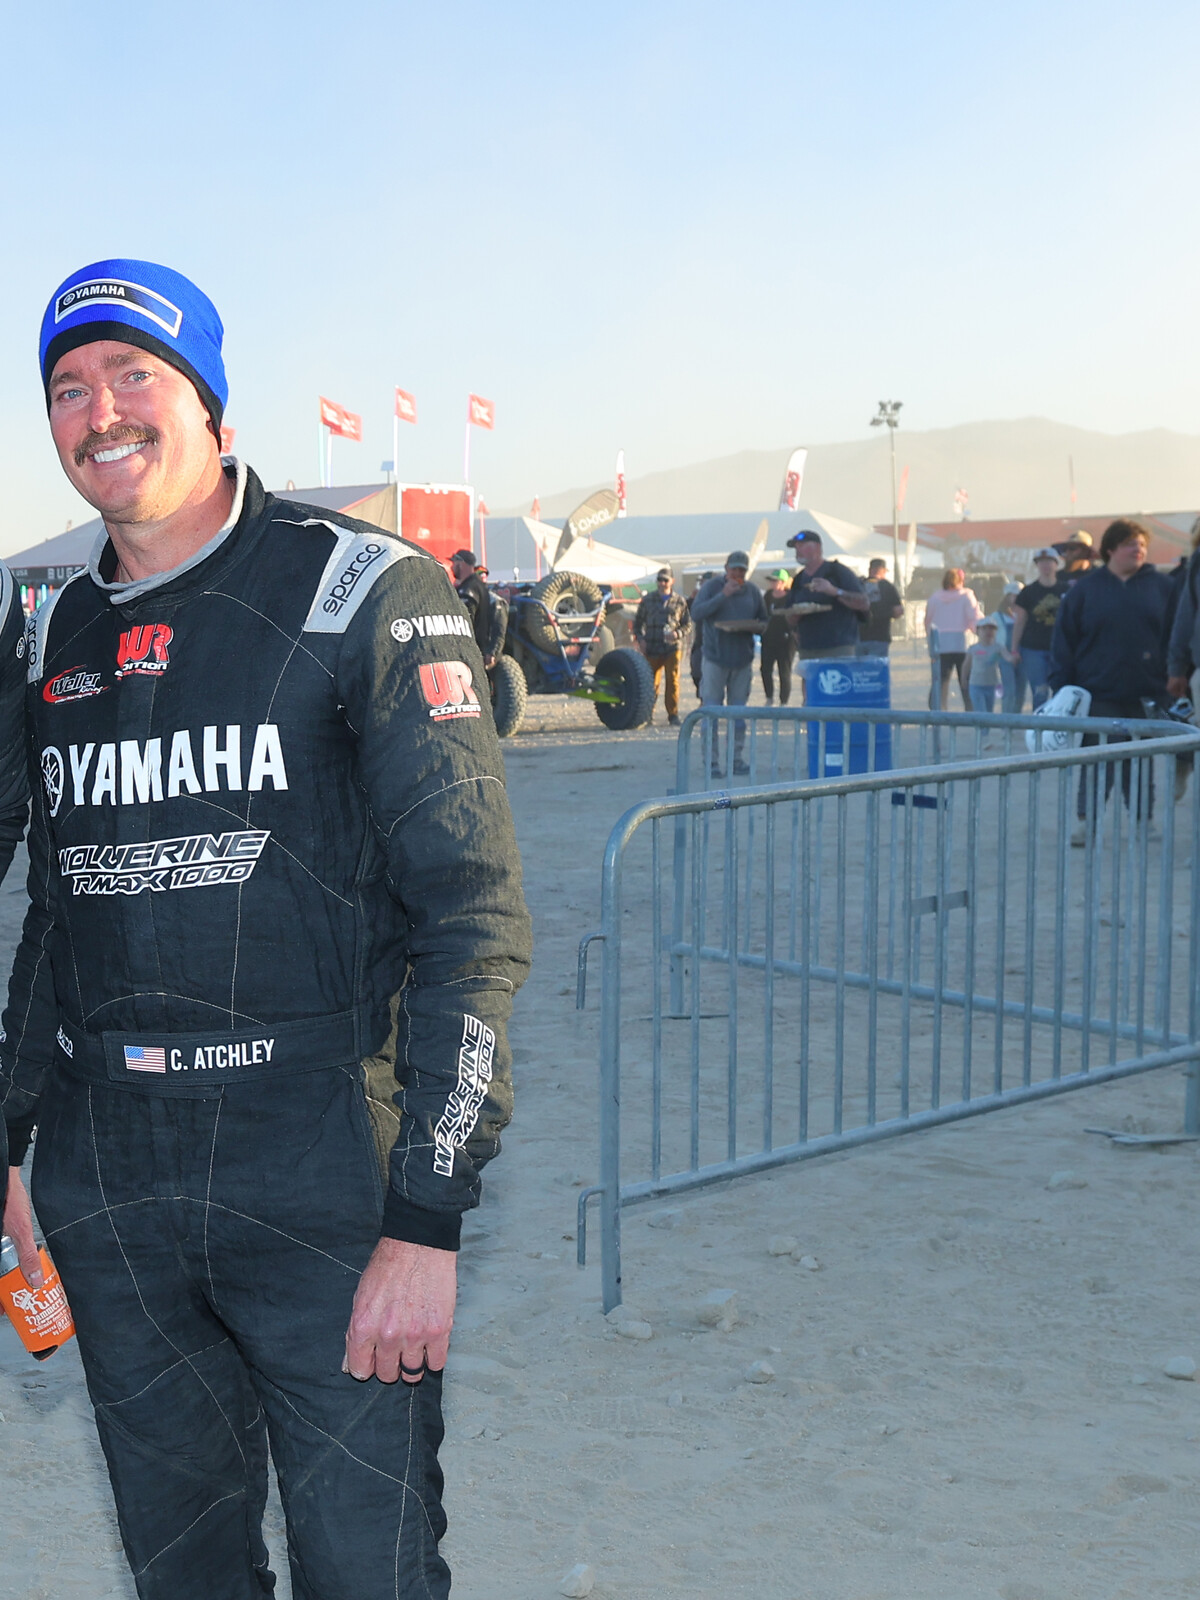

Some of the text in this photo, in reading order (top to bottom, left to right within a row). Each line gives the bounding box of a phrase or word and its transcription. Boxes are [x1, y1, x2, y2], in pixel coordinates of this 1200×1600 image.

[75, 285, 126, 299] YAMAHA
[323, 543, 385, 617] sparco
[52, 672, 101, 696] Weller
[68, 724, 289, 806] YAMAHA
[58, 830, 271, 876] WOLVERINE
[72, 861, 257, 896] RMAX 1000
[170, 1038, 275, 1072] C. ATCHLEY
[479, 1024, 496, 1083] 1000
[433, 1013, 483, 1178] WOLVERINE
